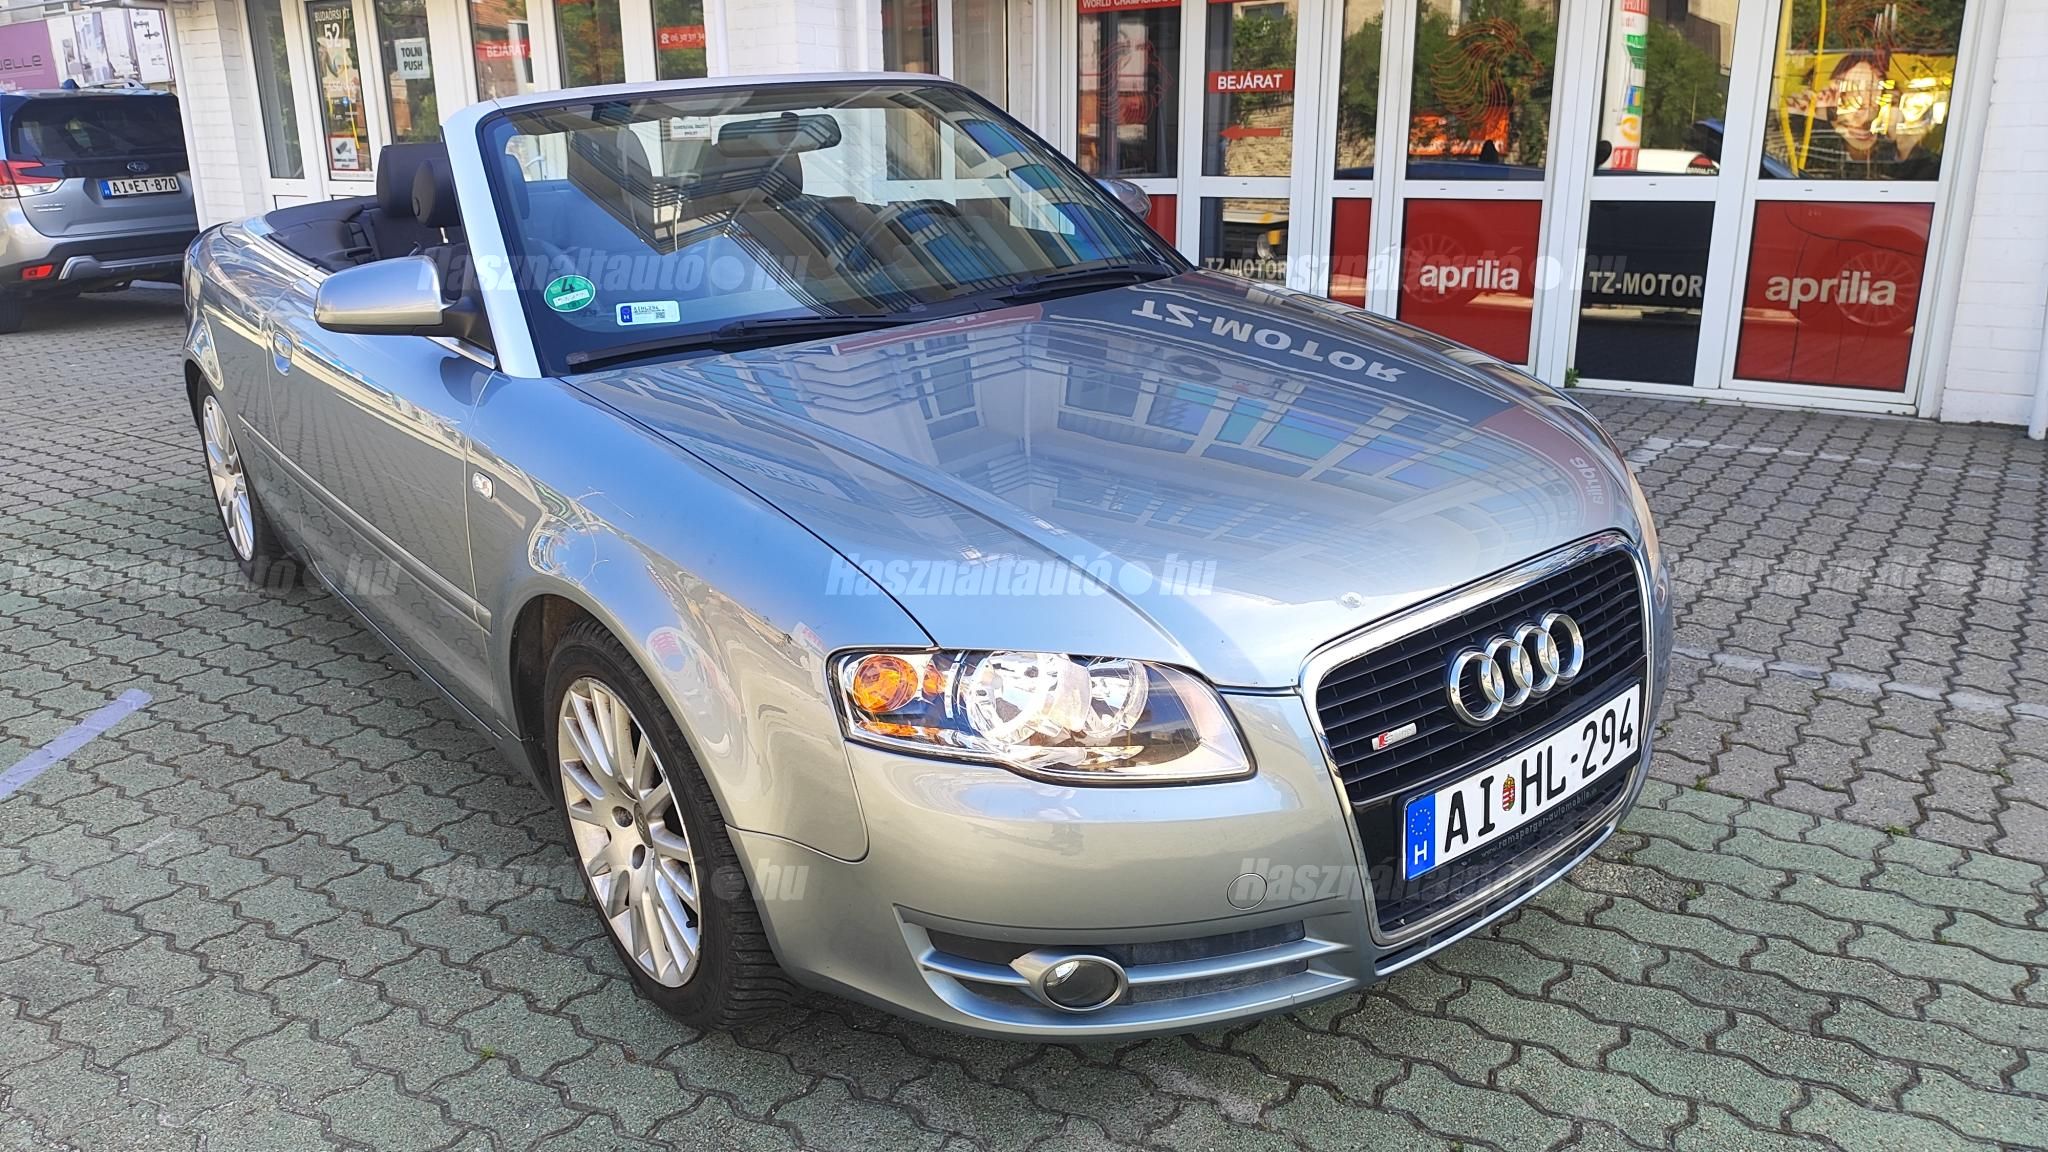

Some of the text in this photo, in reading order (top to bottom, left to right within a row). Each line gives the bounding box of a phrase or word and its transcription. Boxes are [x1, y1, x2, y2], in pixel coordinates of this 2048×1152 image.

[324, 22, 341, 48] 52
[401, 46, 423, 58] TOLNI
[486, 44, 527, 58] BEJÁRAT
[403, 60, 424, 72] PUSH
[1217, 71, 1283, 90] BEJÁRAT
[562, 278, 576, 293] 4
[1419, 260, 1520, 295] aprilia
[1588, 271, 1704, 298] TZ-MOTOR
[1765, 271, 1897, 310] aprilia
[1414, 847, 1428, 866] H
